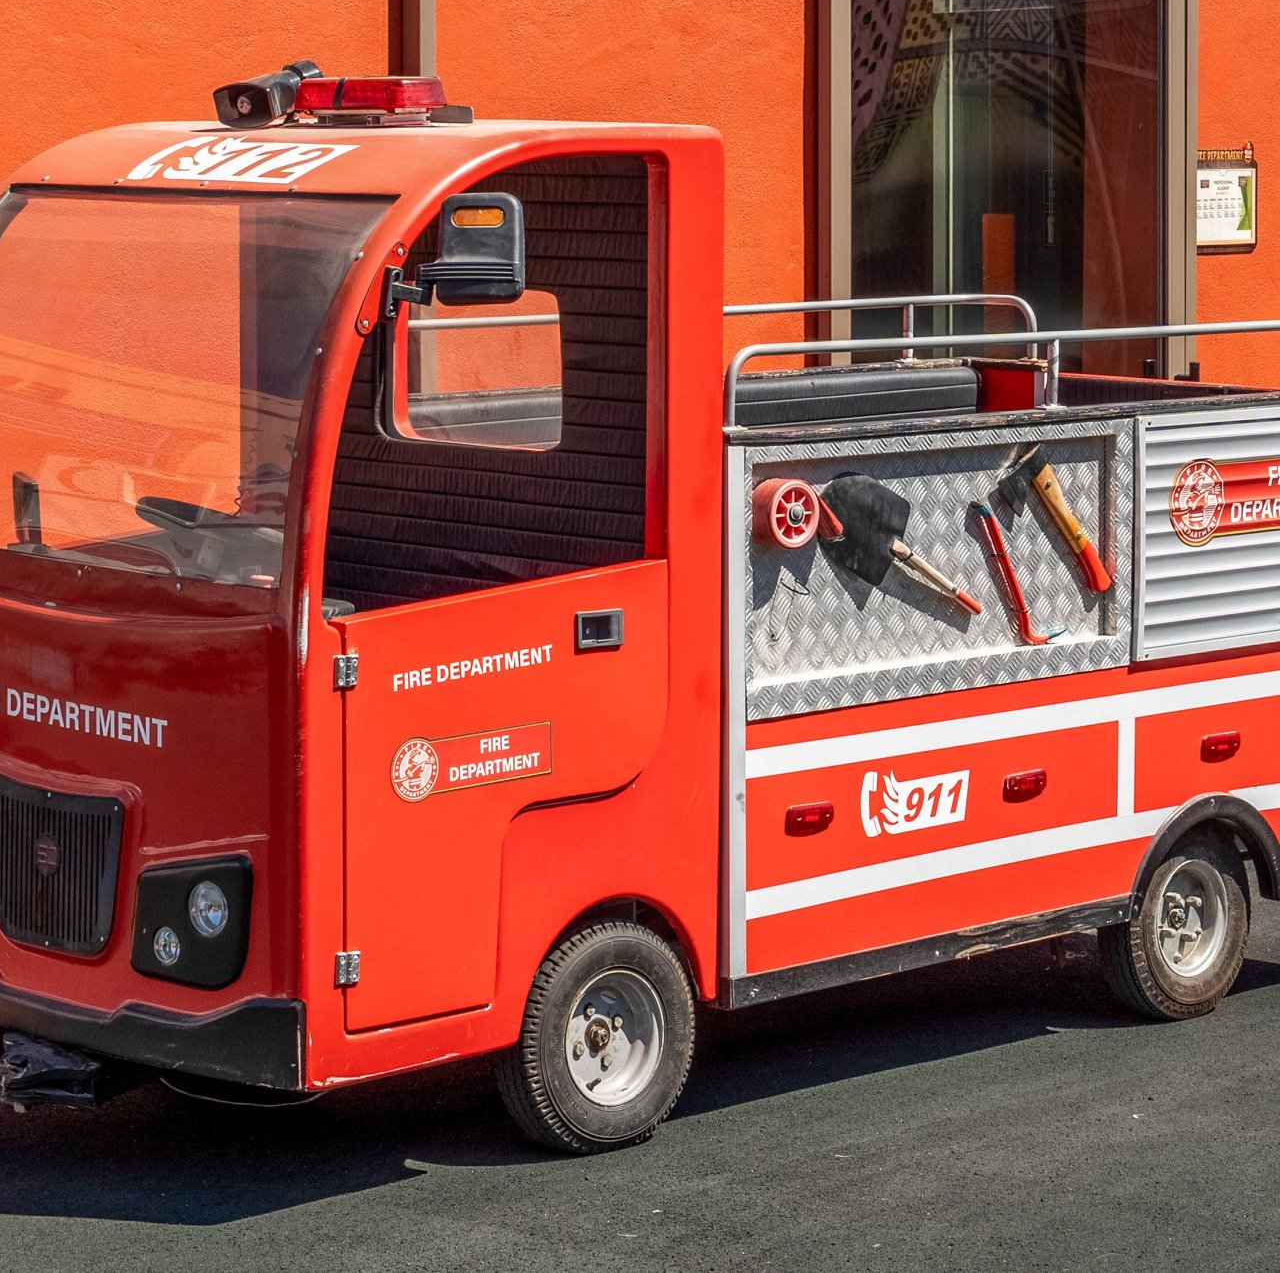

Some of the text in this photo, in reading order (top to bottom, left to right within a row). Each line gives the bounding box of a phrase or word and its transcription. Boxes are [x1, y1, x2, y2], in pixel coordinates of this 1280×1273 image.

[393, 644, 553, 692] FIRE DEPARTMENT
[7, 688, 168, 748] DEPARTMENT
[449, 752, 540, 782] DEPARTMENT
[479, 735, 510, 754] FIRE
[903, 778, 963, 823] 911
